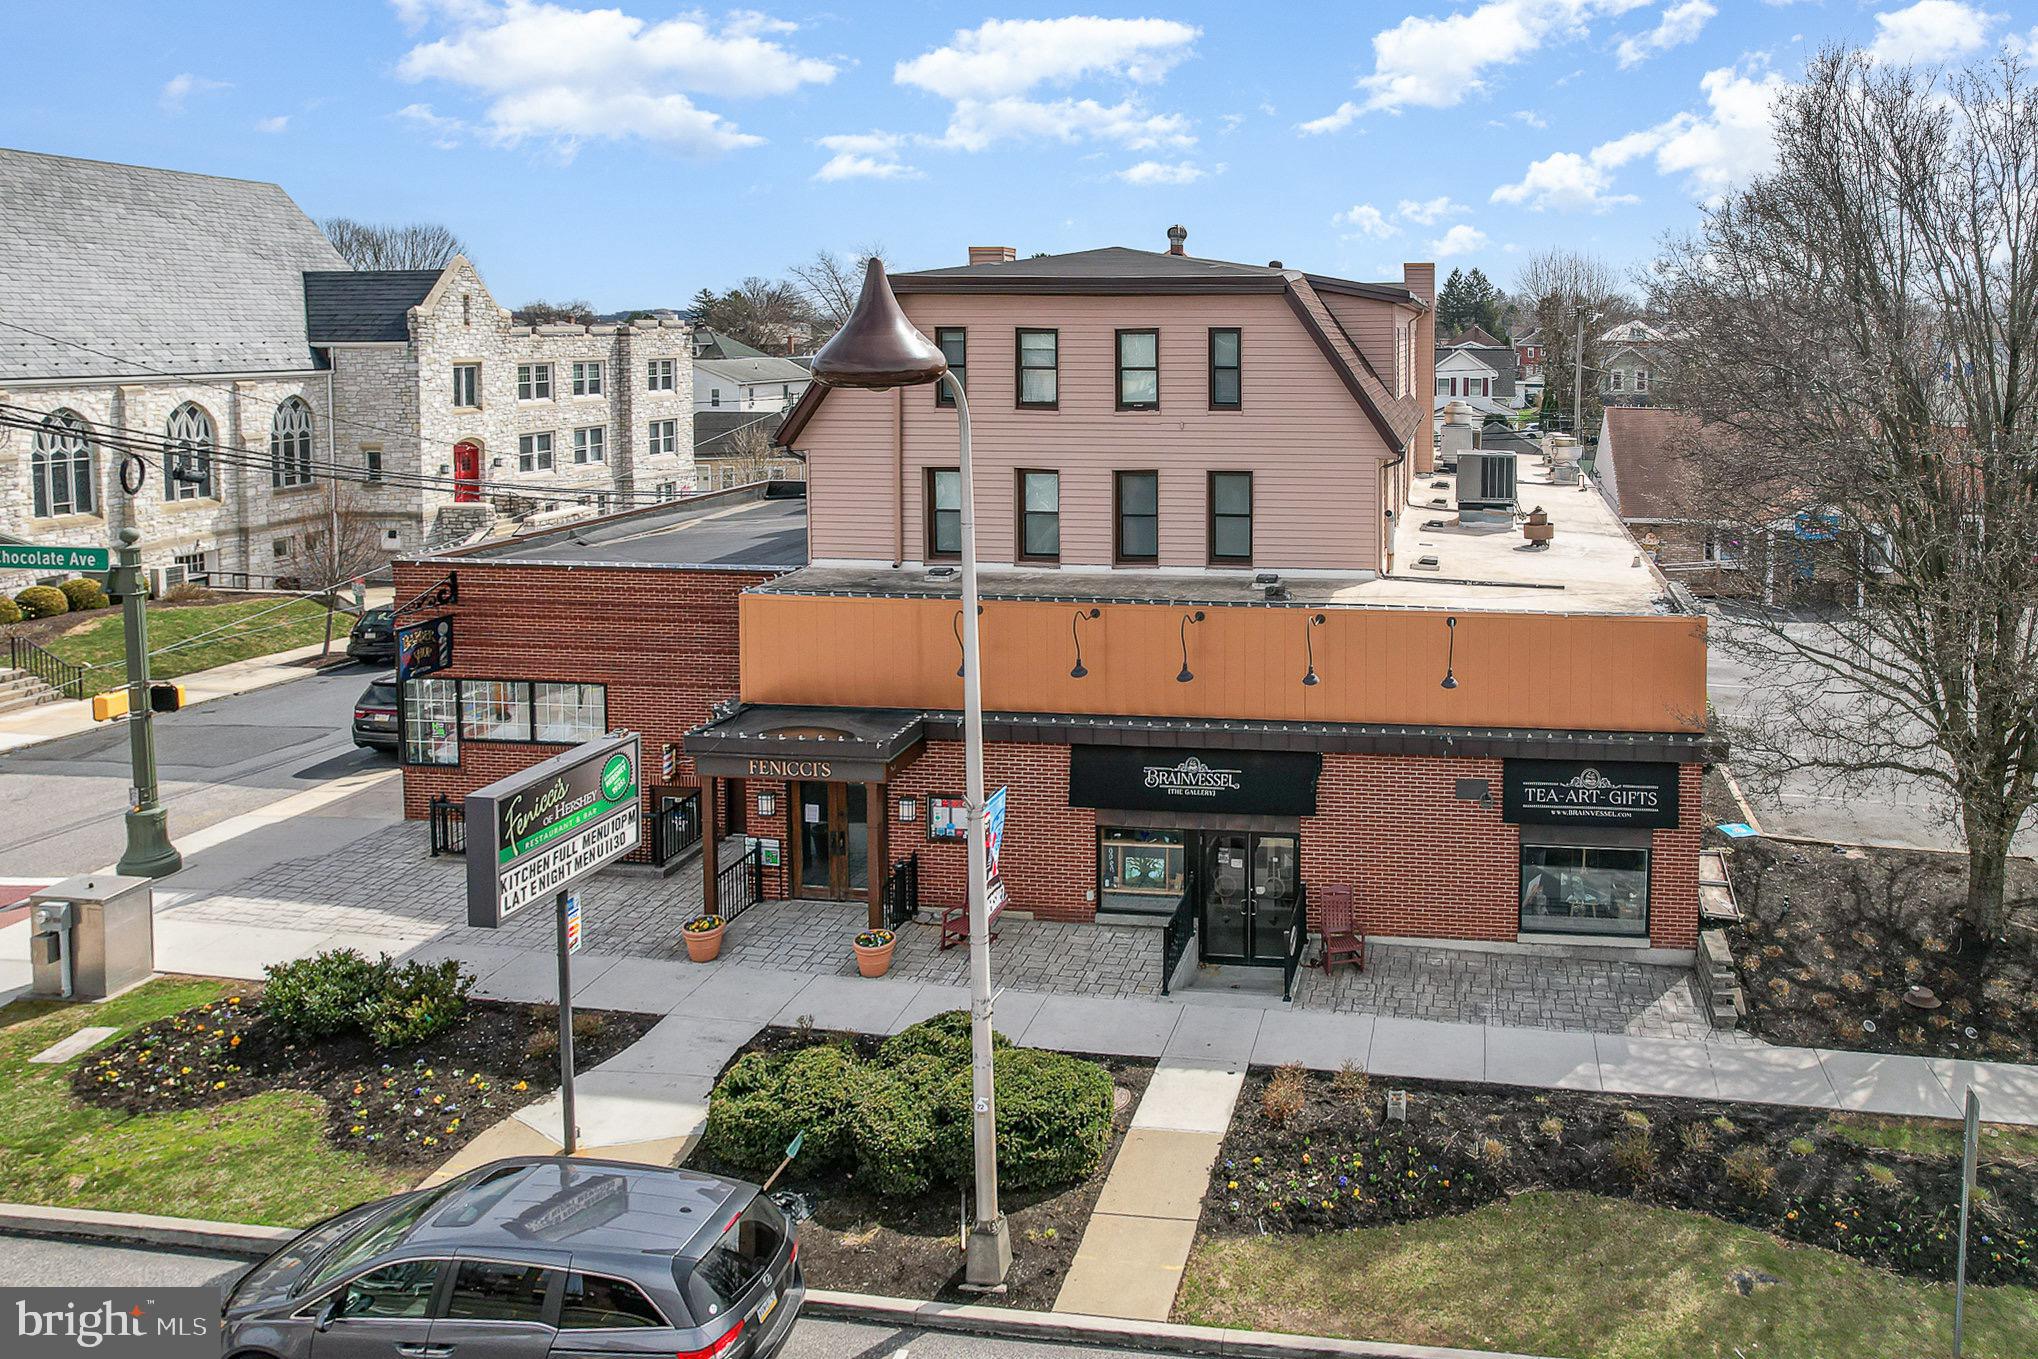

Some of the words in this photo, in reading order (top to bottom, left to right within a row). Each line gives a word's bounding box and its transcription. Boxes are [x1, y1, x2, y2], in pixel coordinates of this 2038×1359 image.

[0, 550, 65, 566] hocolate
[69, 552, 96, 566] Ave
[749, 760, 832, 778] FENICCI'S
[1144, 768, 1240, 789] BRAINVESSEL
[505, 777, 570, 857] Fenicci's
[542, 814, 553, 827] OF
[554, 790, 598, 821] HERSHEY
[525, 820, 574, 850] RESTAURANT
[583, 807, 598, 819] BAR
[500, 858, 550, 895] KITCHEN
[553, 841, 578, 866] FULL
